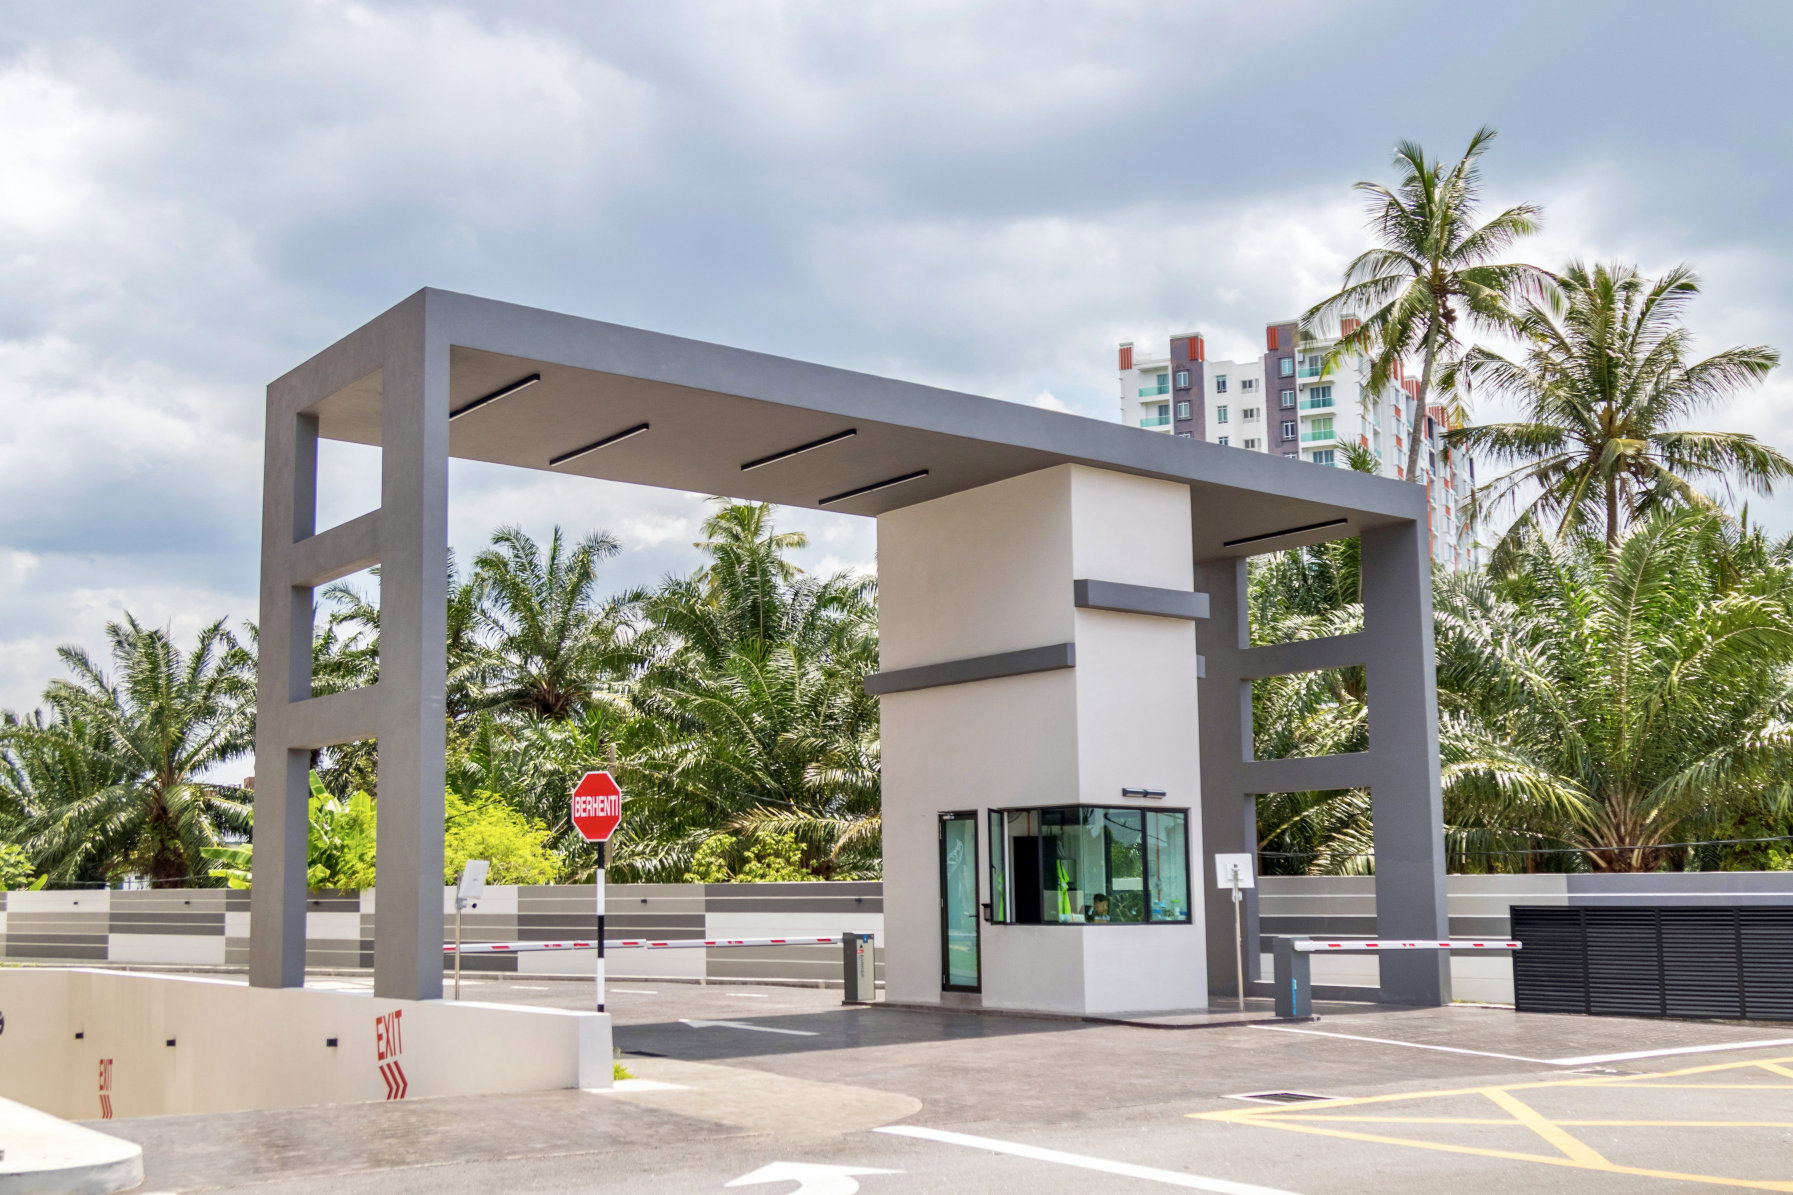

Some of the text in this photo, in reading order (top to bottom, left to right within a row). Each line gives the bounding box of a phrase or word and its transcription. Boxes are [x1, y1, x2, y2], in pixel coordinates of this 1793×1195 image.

[574, 795, 619, 817] BERHENTI
[376, 1009, 402, 1061] EXIT
[99, 1058, 113, 1091] EXIT
